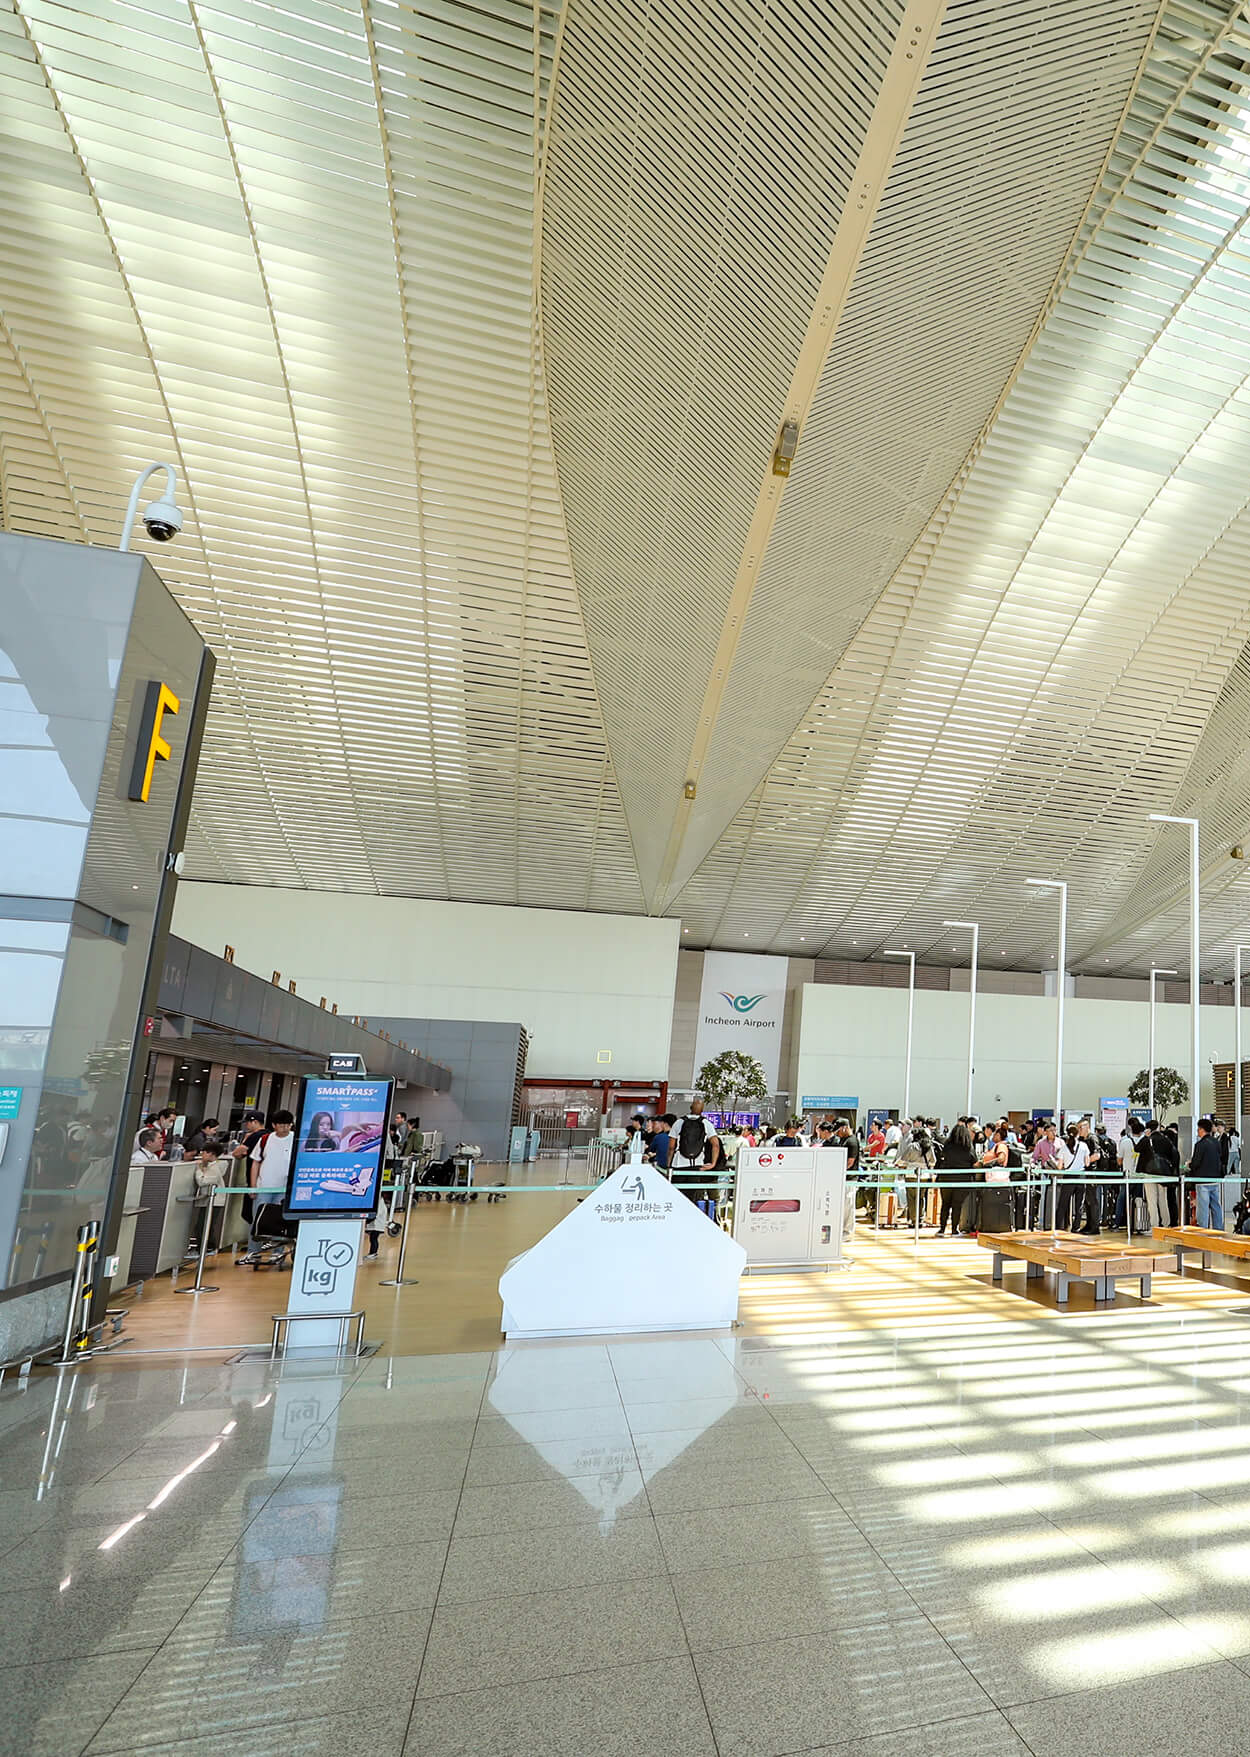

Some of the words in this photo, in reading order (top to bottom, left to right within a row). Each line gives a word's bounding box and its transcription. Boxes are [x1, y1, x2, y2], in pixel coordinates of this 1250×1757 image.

[138, 681, 180, 803] F
[705, 1016, 740, 1026] Incheon
[743, 1018, 775, 1028] Airport
[1226, 1070, 1233, 1088] F
[316, 1086, 373, 1097] SMARTPASS
[595, 1203, 622, 1214] 수하물
[625, 1202, 662, 1214] 정리하는
[664, 1202, 673, 1213] 곳
[308, 1269, 332, 1286] kg
